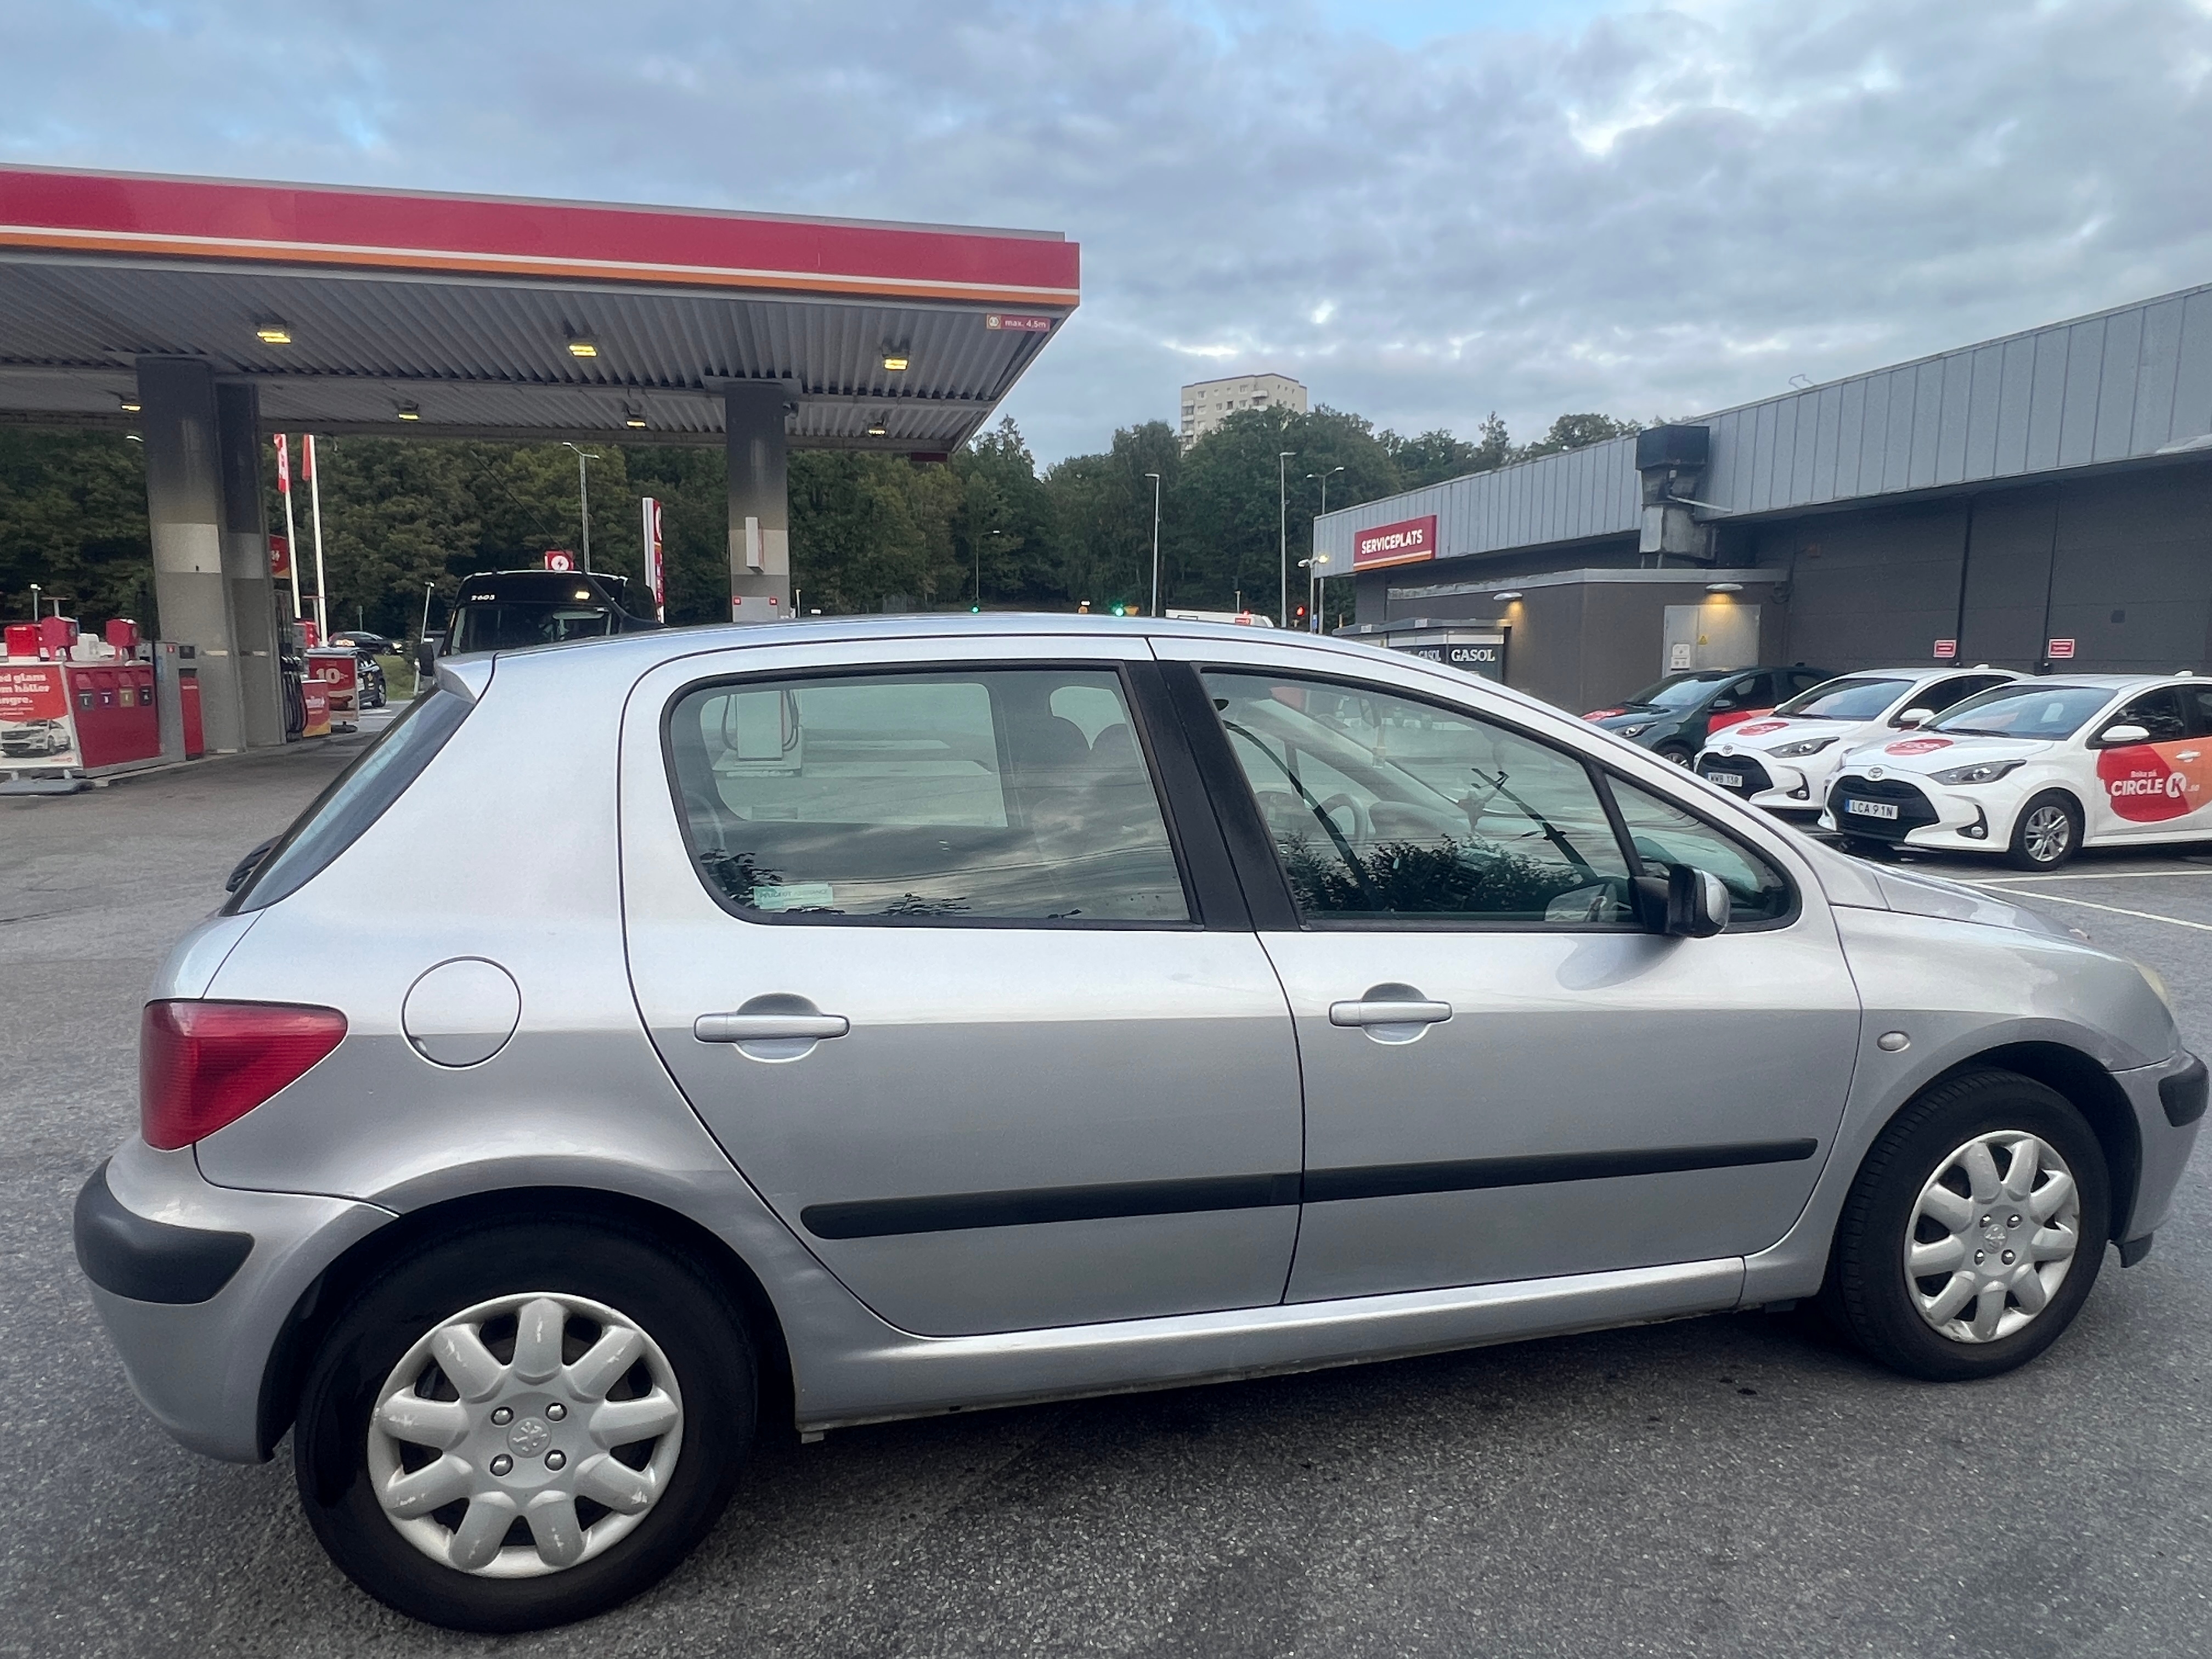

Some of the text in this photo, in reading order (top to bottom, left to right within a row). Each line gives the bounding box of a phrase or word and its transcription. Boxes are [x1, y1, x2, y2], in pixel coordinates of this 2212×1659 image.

[1026, 320, 1046, 329] 4,5m
[1361, 529, 1423, 555] SERVICEPLATS
[1451, 649, 1496, 662] GASOL
[2111, 778, 2164, 796] CIRCLE
[1852, 801, 1870, 813] LCA
